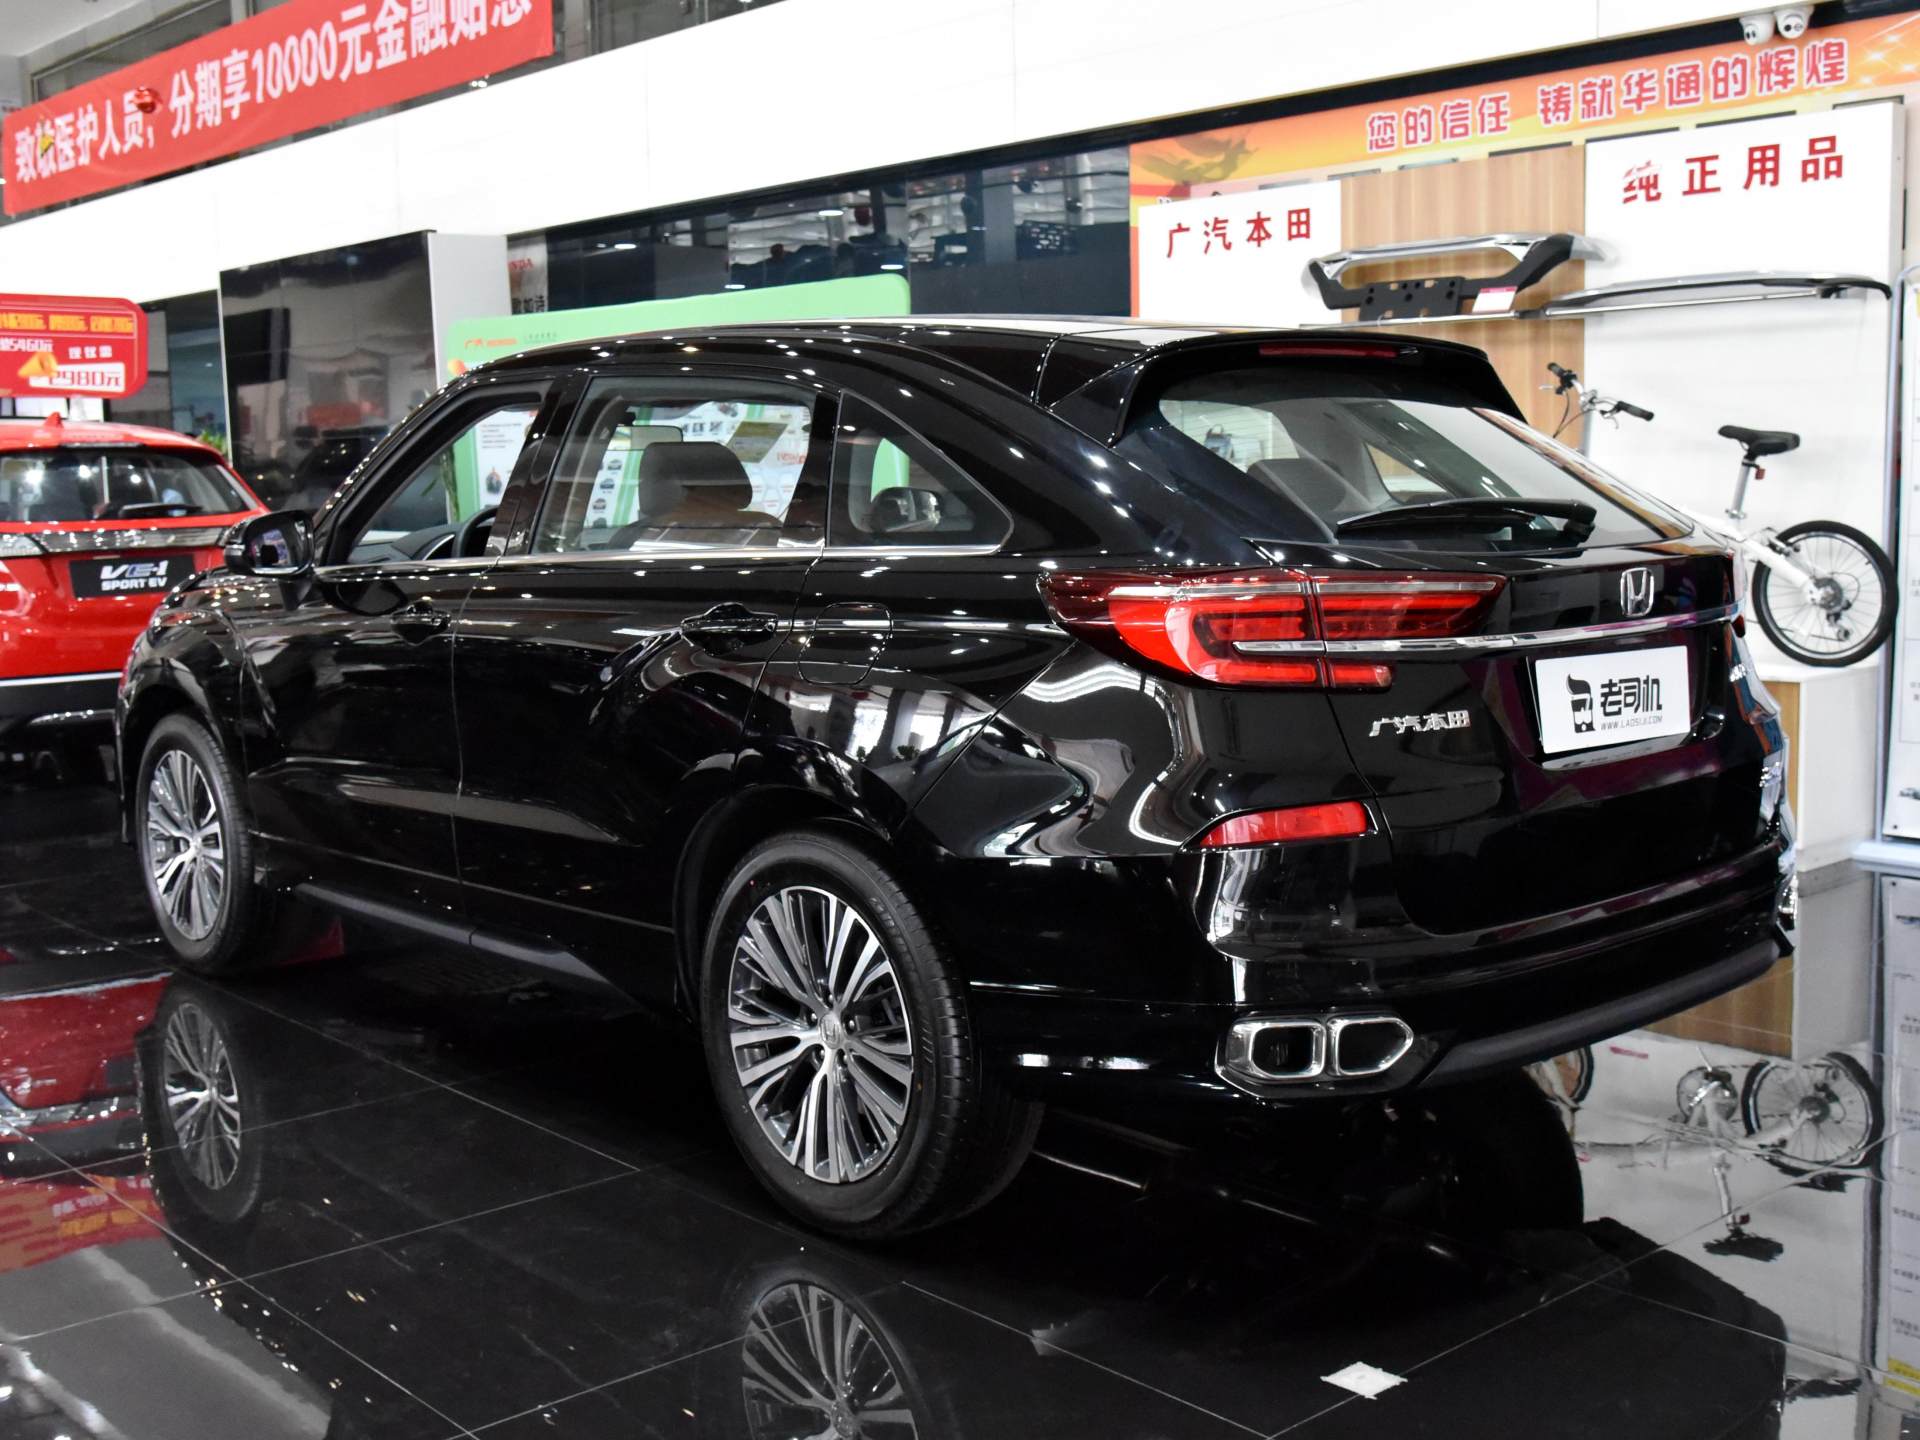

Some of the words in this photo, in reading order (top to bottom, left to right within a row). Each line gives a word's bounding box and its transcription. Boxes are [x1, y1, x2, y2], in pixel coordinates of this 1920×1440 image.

[1368, 94, 1509, 151] 您的信任
[1539, 40, 1849, 126] 铸就华通的辉煌
[1622, 136, 1844, 204] 纯正用品
[1167, 208, 1311, 258] 广汽本田
[102, 578, 147, 591] SPORT
[148, 577, 168, 588] EV
[1600, 674, 1664, 717] 老司机
[1369, 709, 1471, 737] 广汽本田
